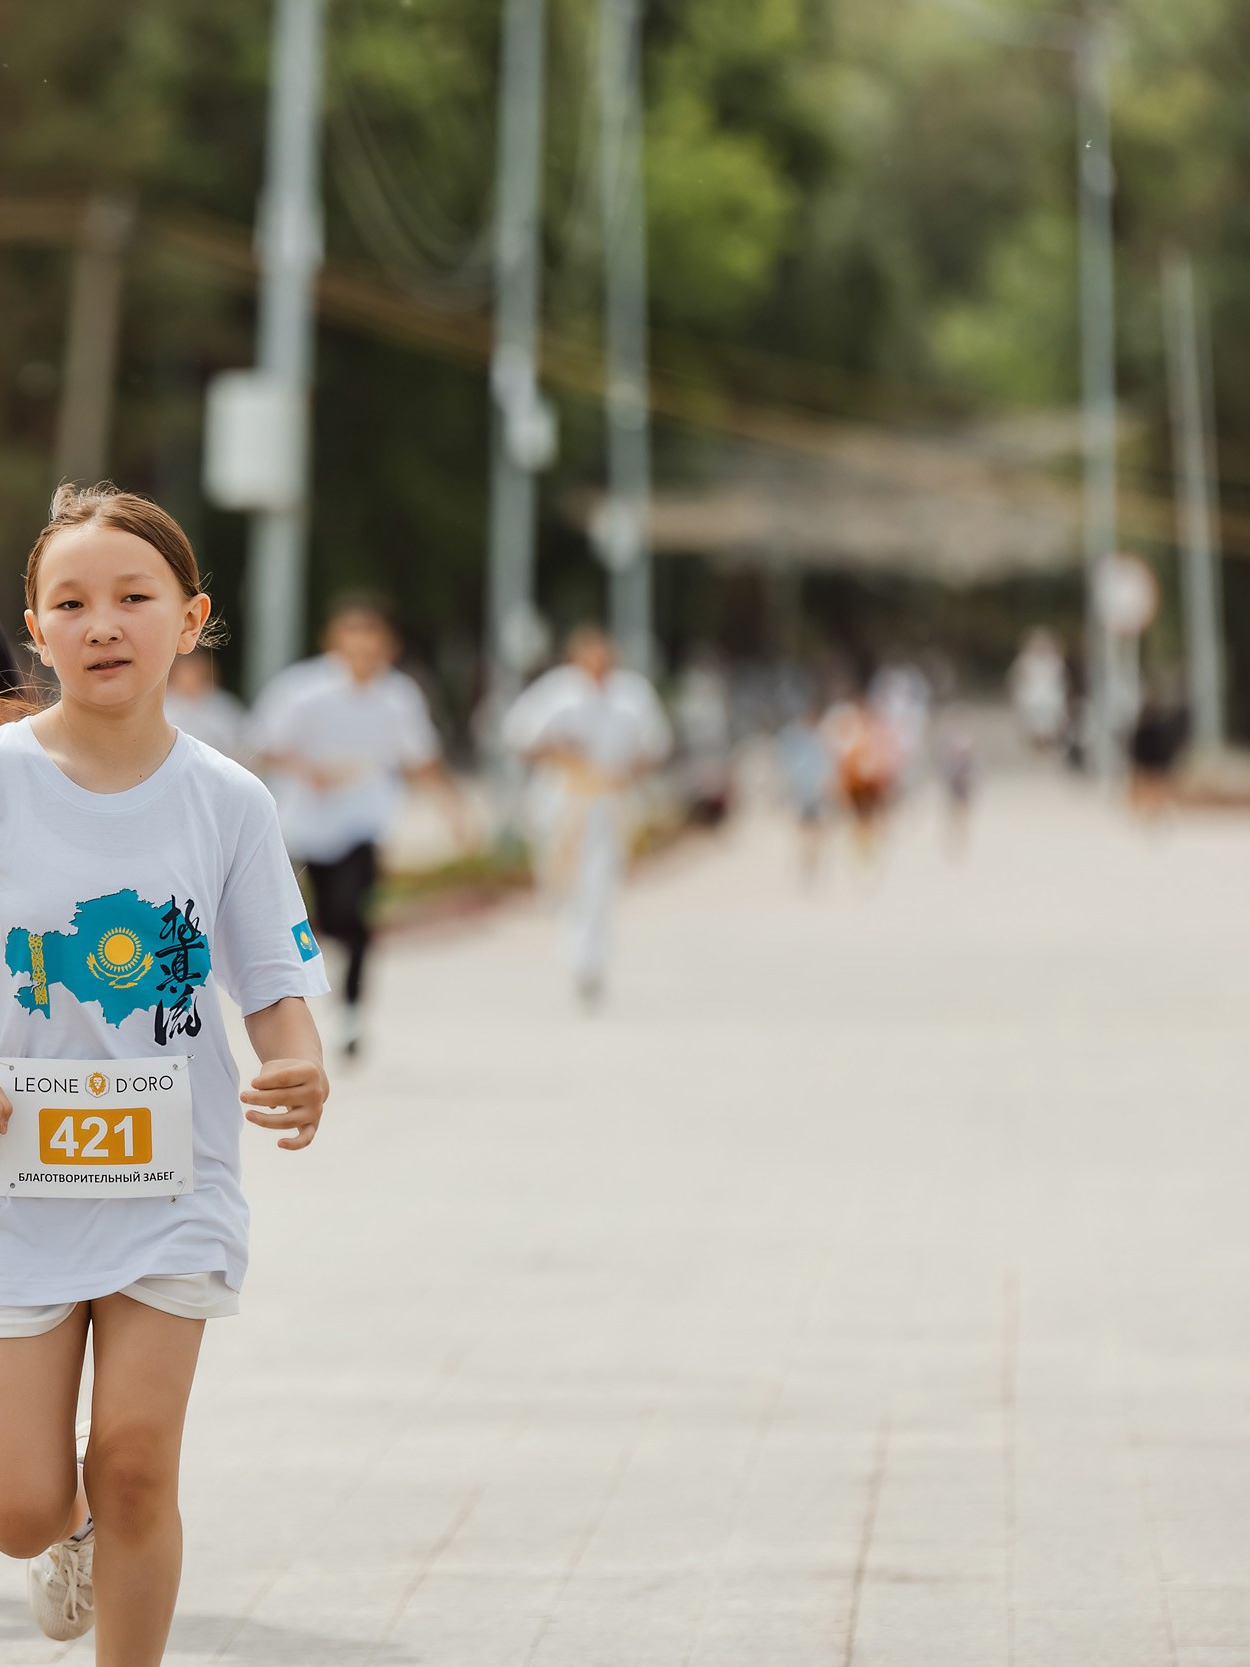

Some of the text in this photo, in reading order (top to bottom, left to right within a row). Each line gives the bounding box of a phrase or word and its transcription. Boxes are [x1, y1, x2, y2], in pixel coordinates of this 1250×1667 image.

[14, 1075, 174, 1093] LEONE D'ORO
[50, 1115, 134, 1157] 421
[18, 1171, 174, 1183] БЛАГОТВОРИТЕЛЬНЫЙ ЗАБЕГ
